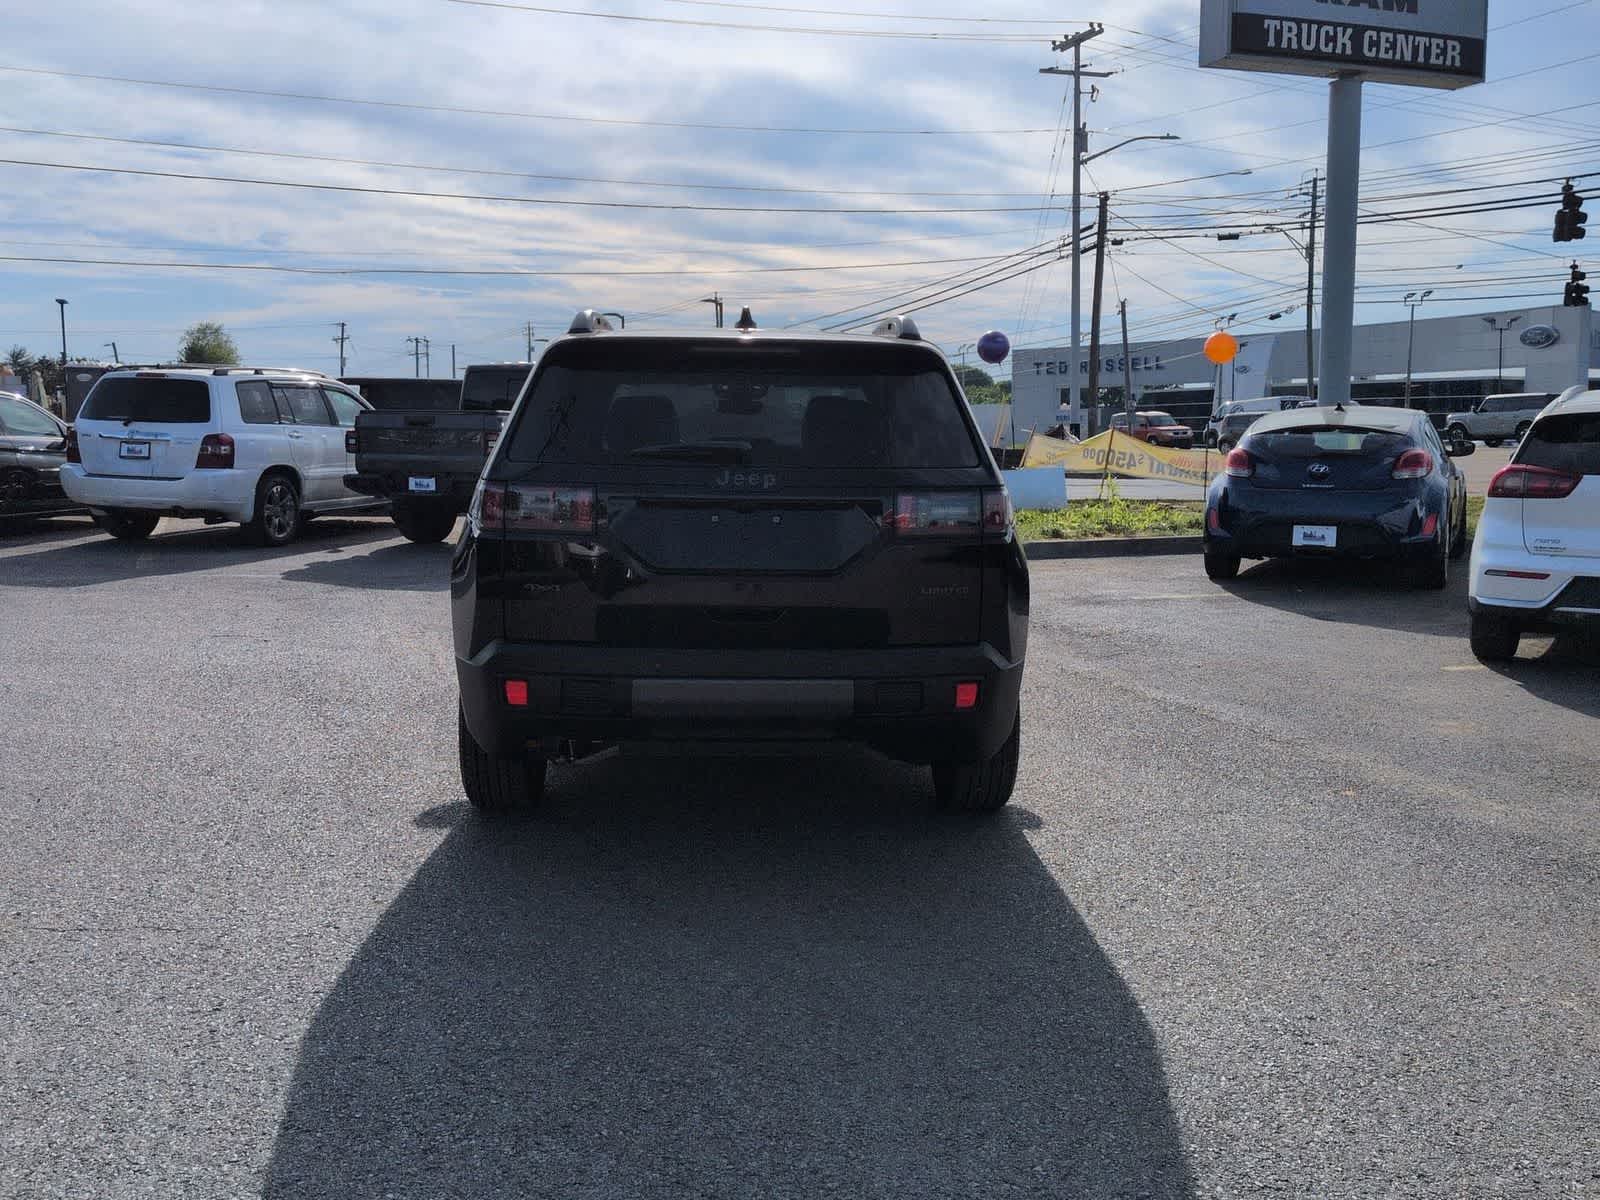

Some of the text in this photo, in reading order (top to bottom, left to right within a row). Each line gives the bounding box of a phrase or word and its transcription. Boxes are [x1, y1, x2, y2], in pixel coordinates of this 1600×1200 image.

[1263, 18, 1462, 68] TRUCK CENTER
[1033, 356, 1166, 375] TED RSSELL
[713, 469, 777, 489] Jeep
